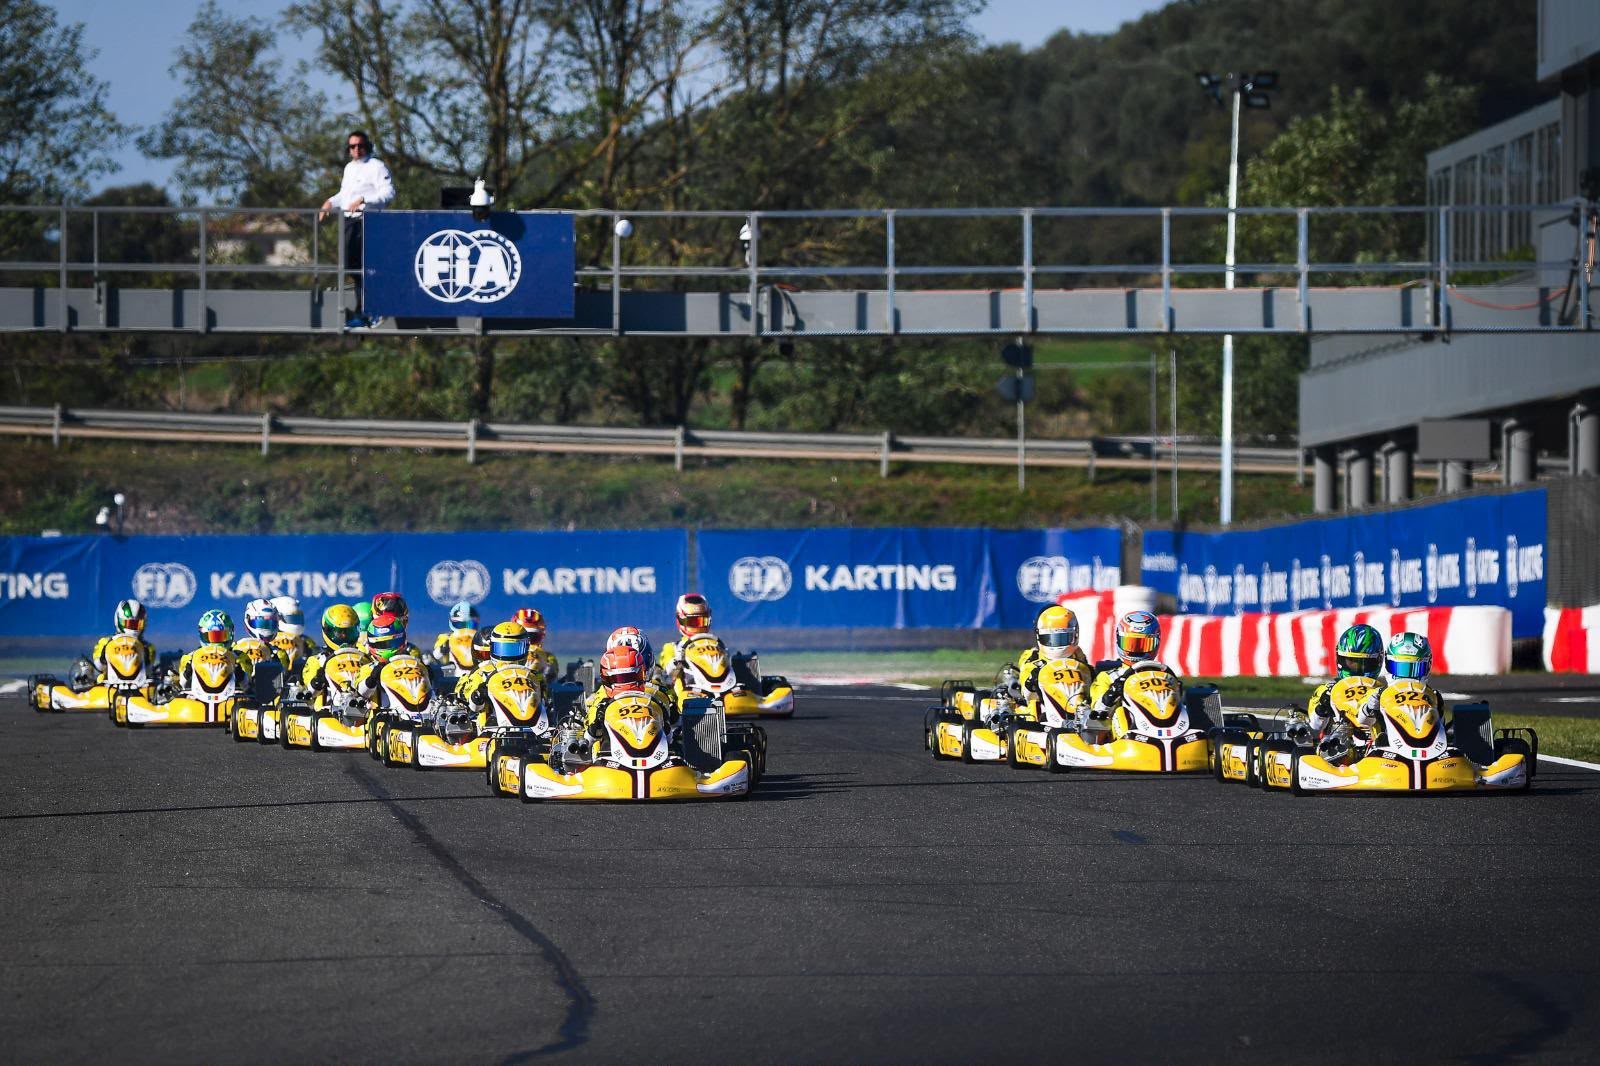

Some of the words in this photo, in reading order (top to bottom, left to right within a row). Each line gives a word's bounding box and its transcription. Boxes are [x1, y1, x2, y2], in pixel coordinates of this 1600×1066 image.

[210, 571, 363, 599] KARTING
[502, 566, 657, 595] KARTING
[805, 564, 957, 591] KARTING
